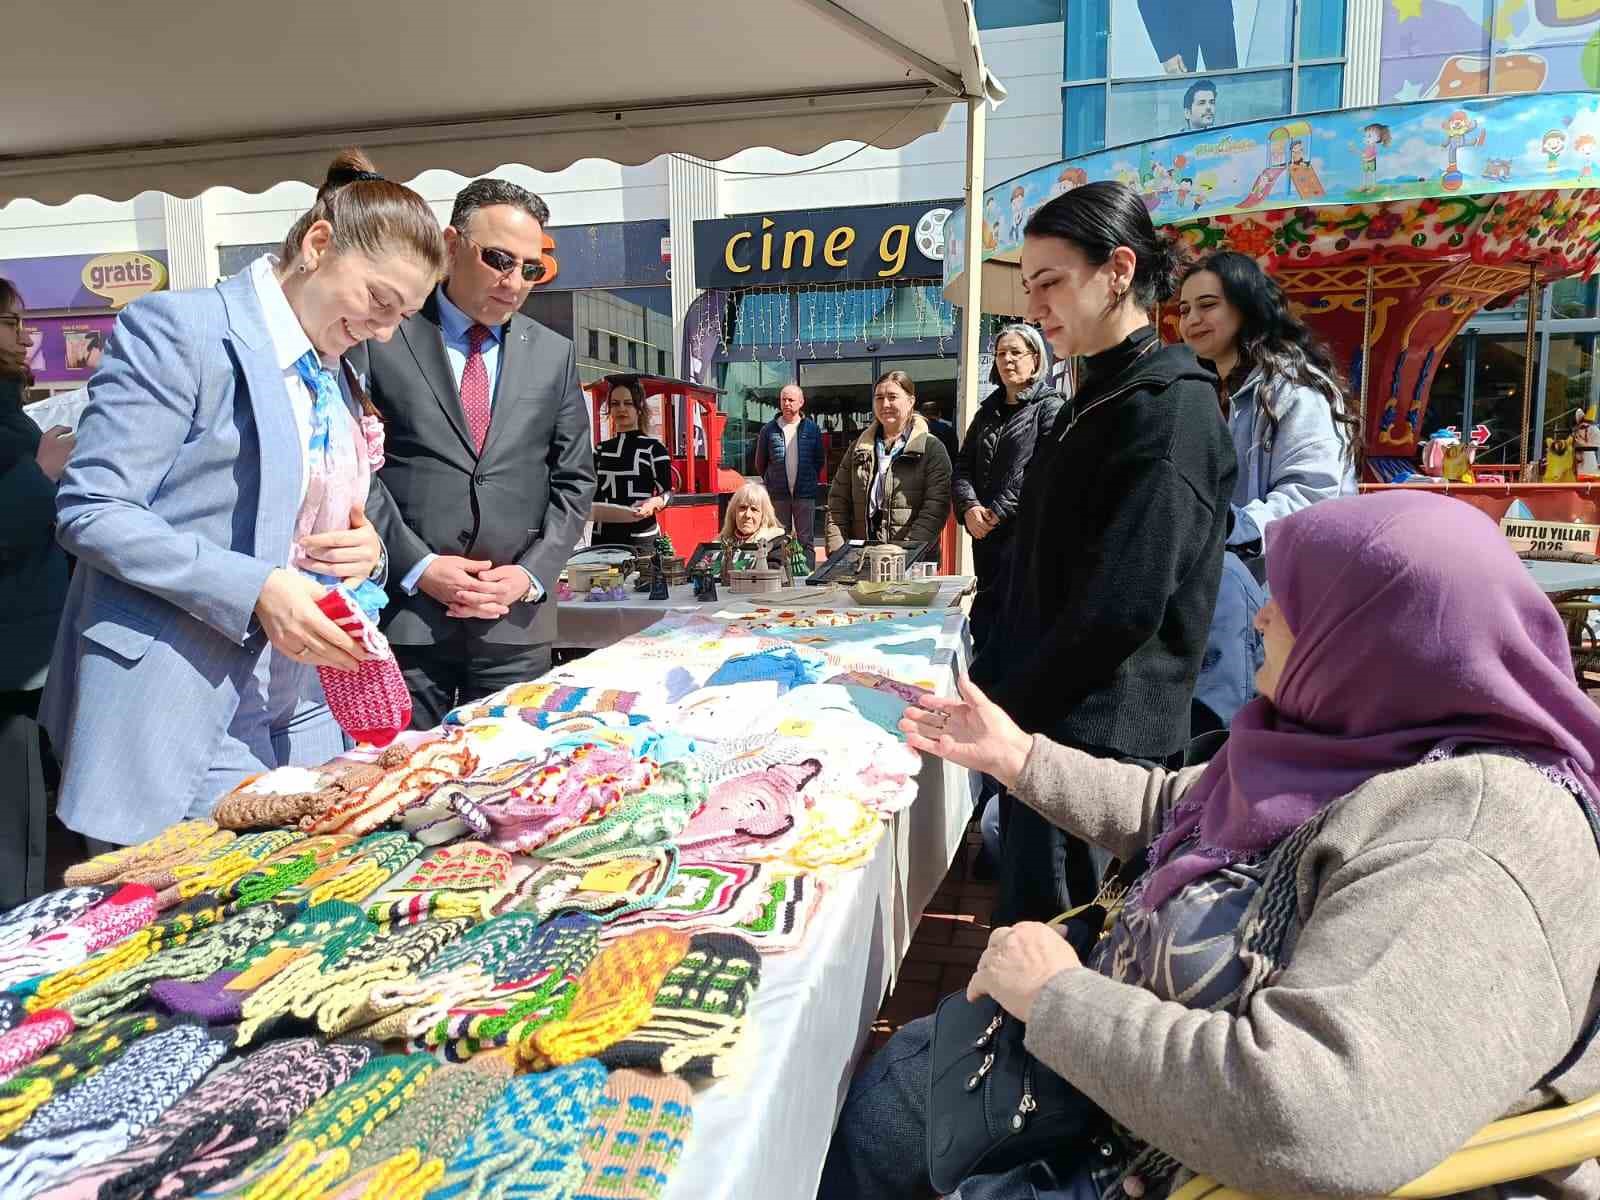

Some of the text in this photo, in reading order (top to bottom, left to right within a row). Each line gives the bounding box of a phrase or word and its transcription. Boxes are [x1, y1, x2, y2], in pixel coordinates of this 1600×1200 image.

[725, 216, 856, 273] cine
[90, 257, 153, 289] gratis
[1505, 524, 1591, 542] MUTLU YILLAR
[1529, 540, 1564, 551] 2026
